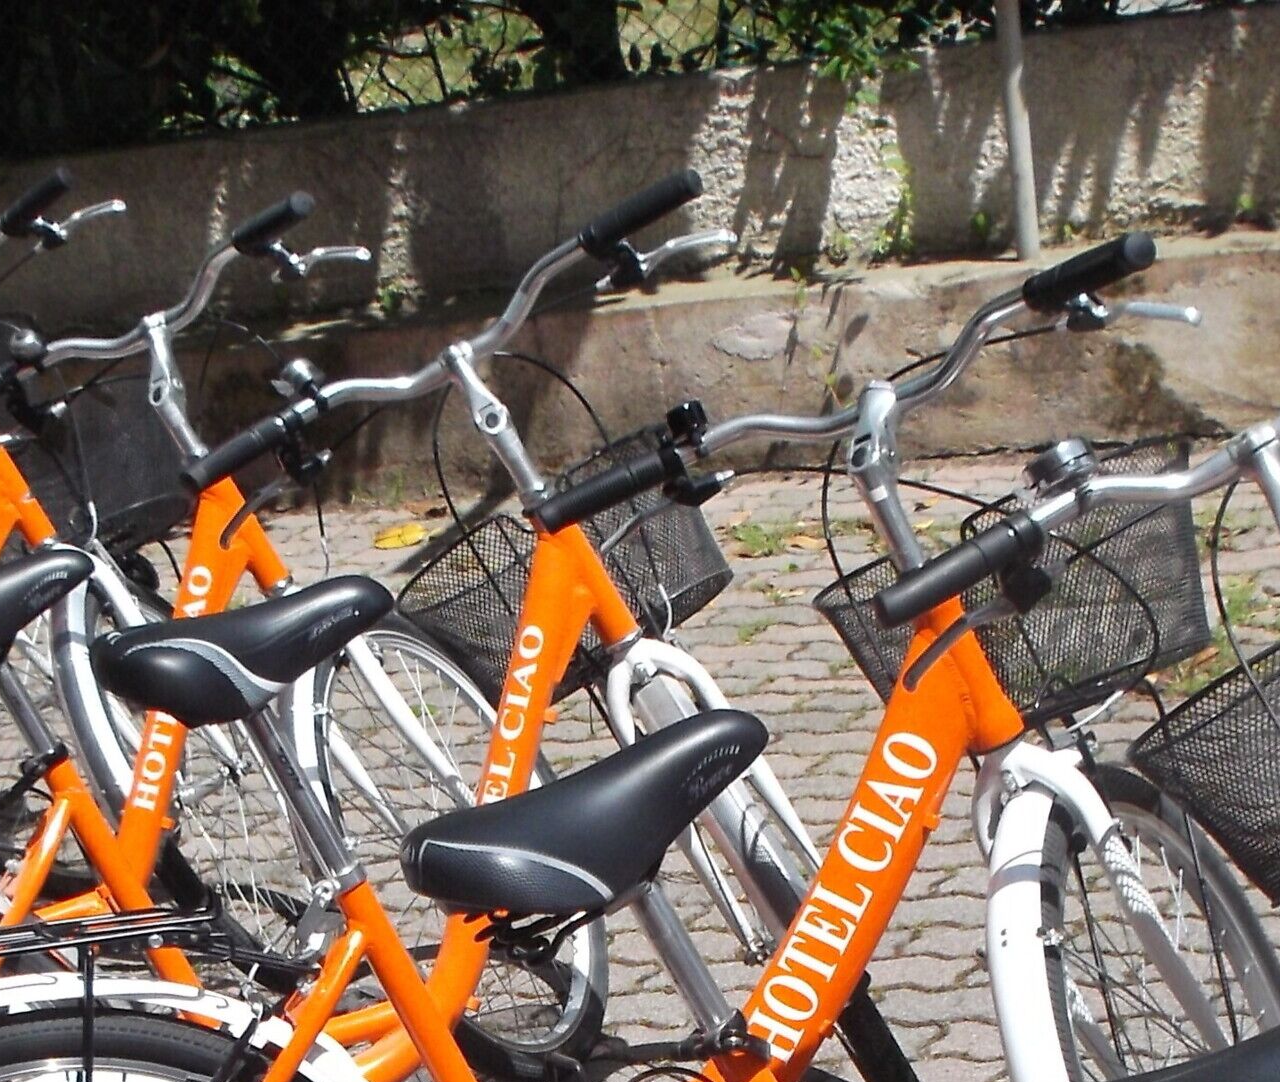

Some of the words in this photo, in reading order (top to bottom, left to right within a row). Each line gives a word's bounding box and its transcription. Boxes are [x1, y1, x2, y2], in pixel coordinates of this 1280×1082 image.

[499, 624, 544, 741] CIAO
[132, 711, 179, 812] HOT
[747, 881, 874, 1064] HOTEL
[837, 731, 938, 873] CIAO
